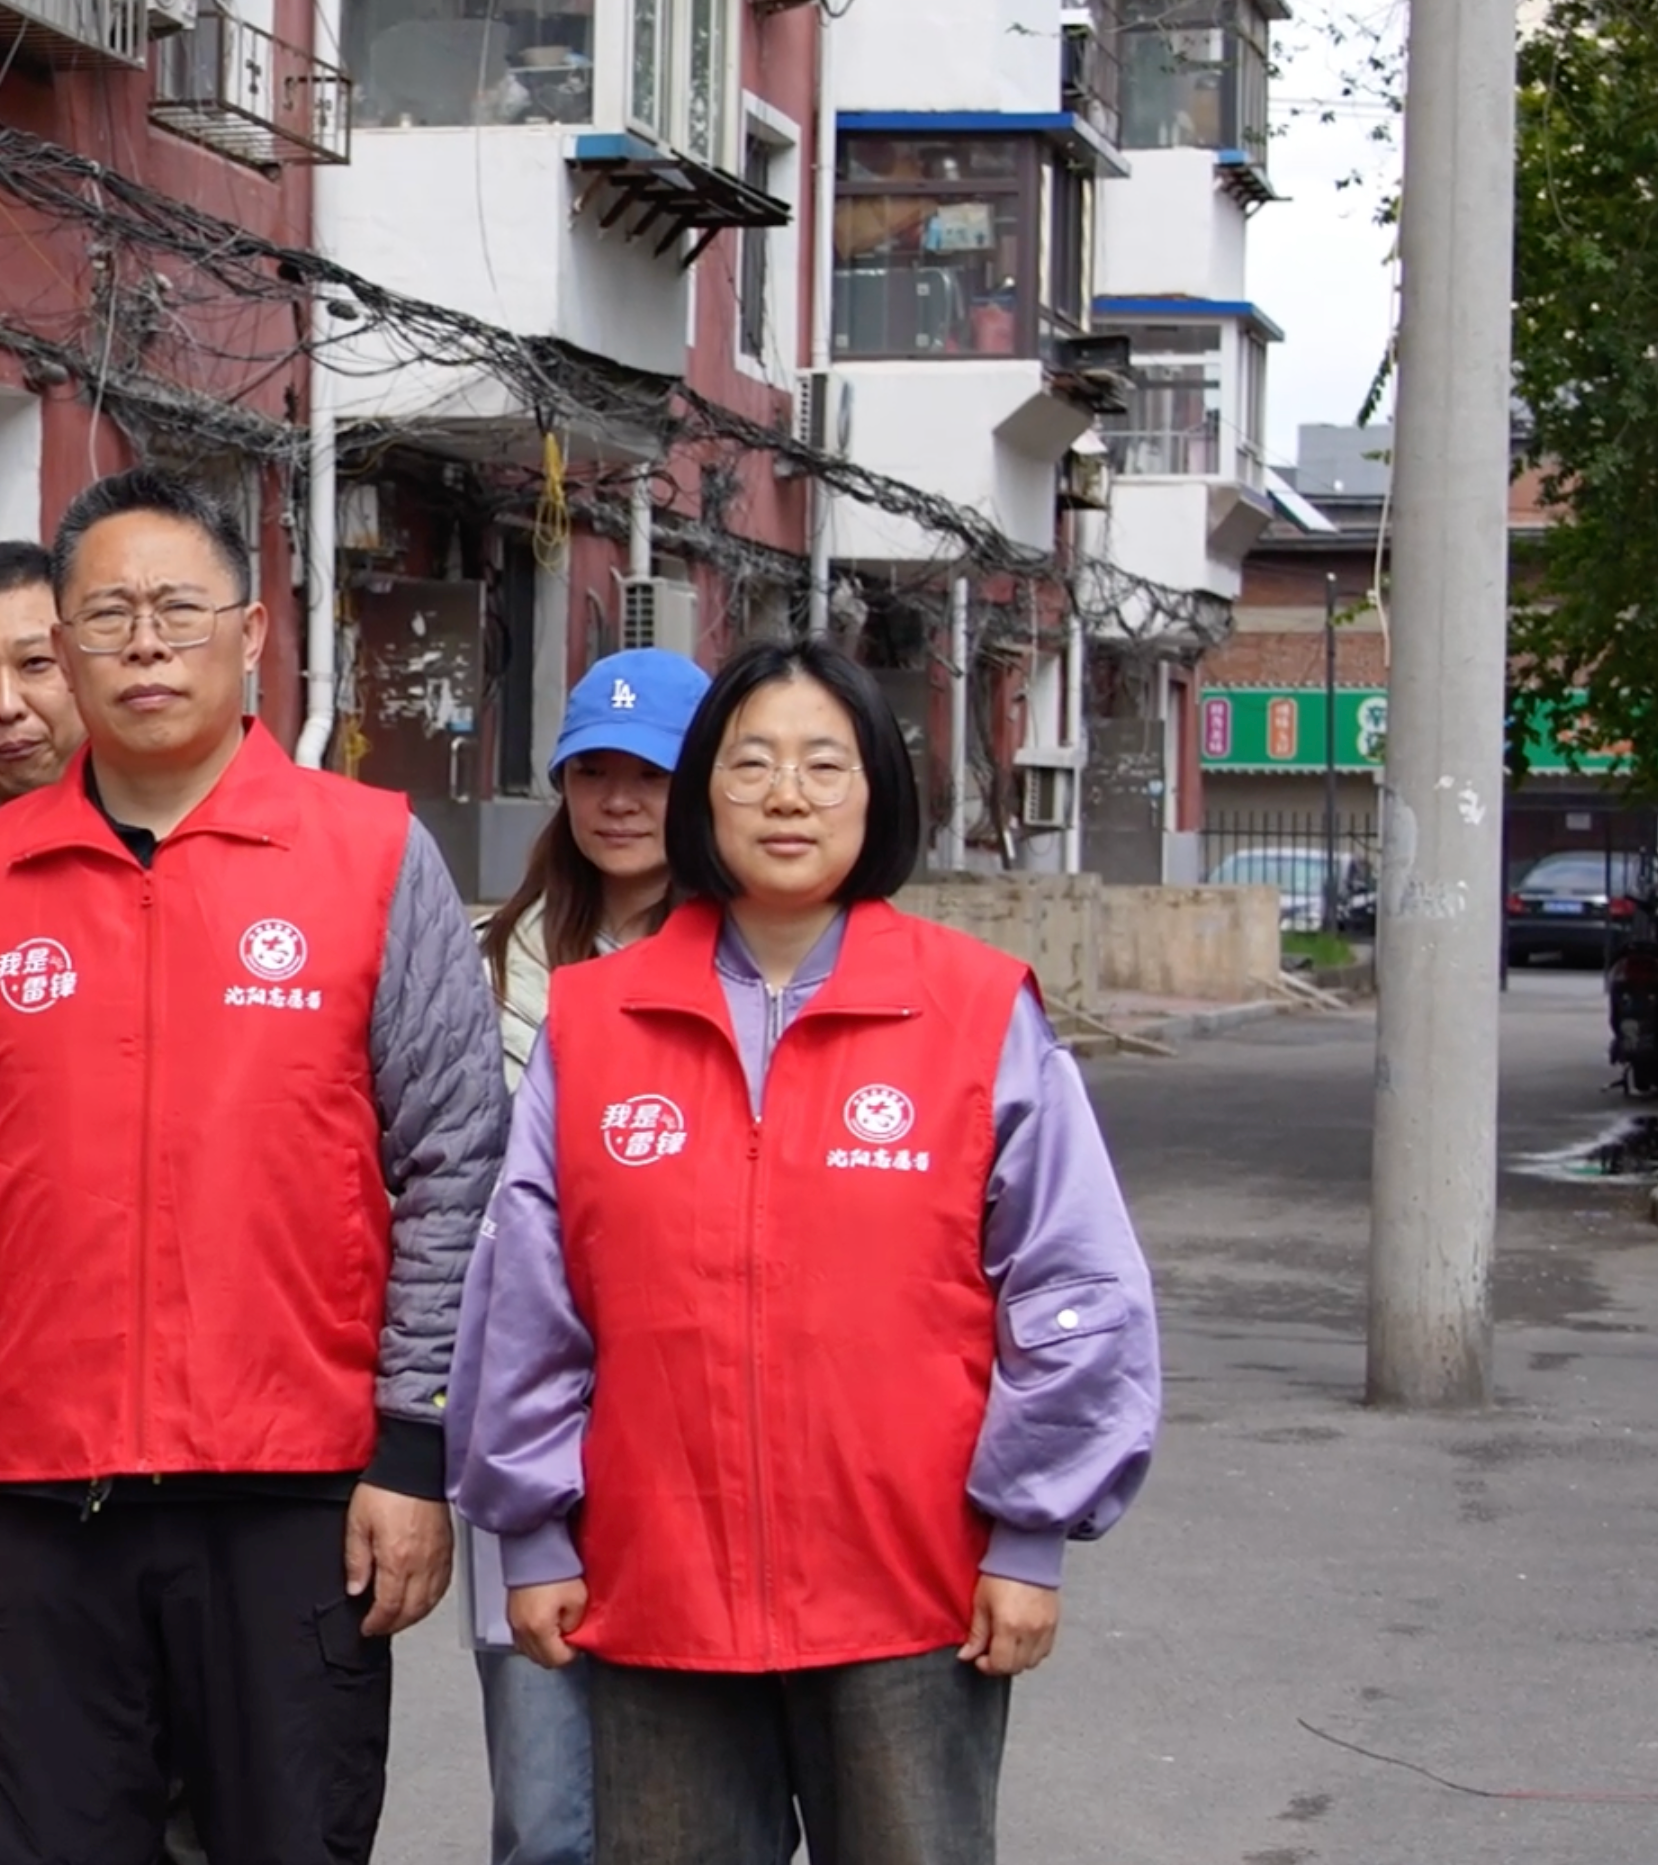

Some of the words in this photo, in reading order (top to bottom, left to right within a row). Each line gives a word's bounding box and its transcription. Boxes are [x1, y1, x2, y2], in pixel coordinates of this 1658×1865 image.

[611, 679, 636, 709] LA
[22, 971, 77, 1003] 雷锋
[600, 1103, 662, 1130] 我是
[624, 1131, 688, 1157] 雷锋
